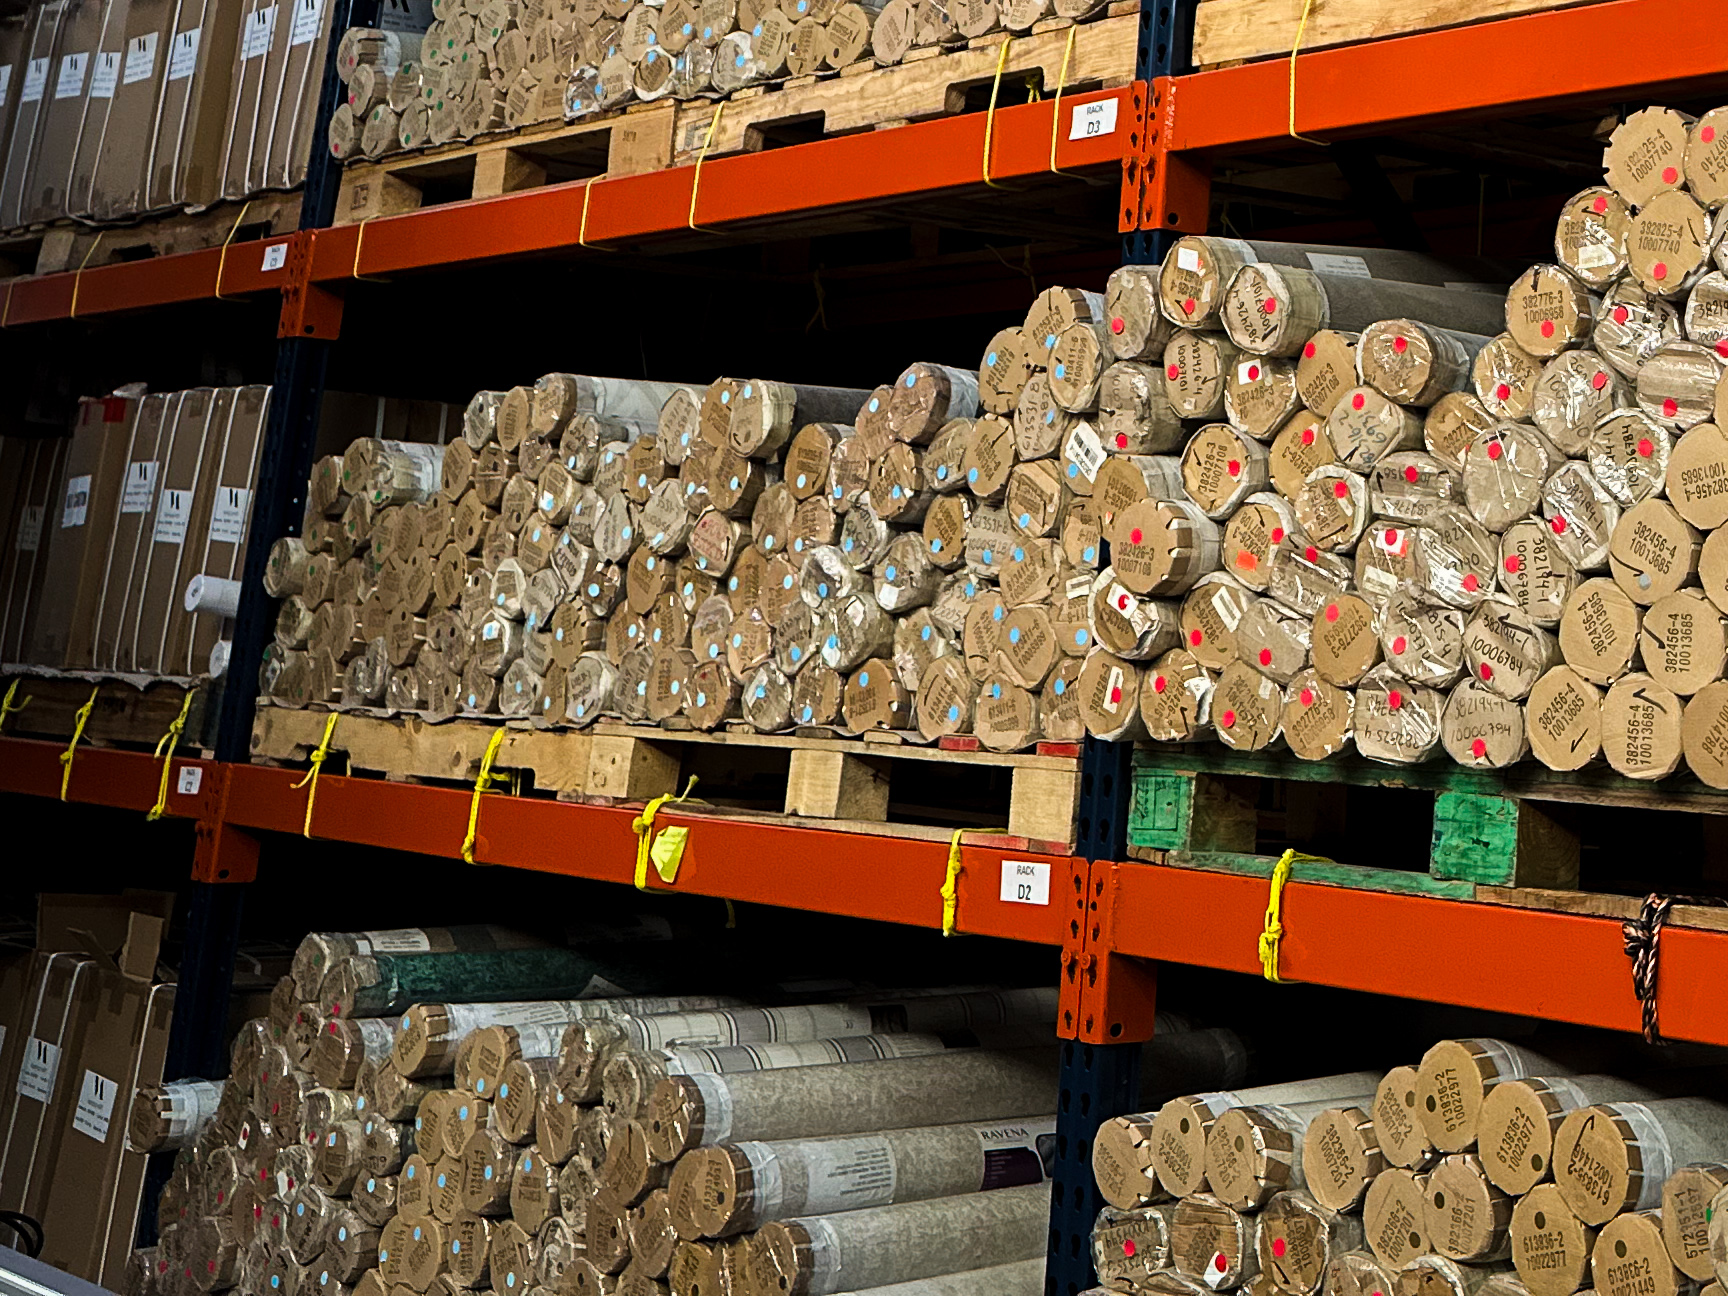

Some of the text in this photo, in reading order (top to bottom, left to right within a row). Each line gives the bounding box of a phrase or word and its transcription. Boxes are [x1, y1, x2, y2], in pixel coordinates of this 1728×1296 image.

[1087, 104, 1103, 114] RACK
[1087, 120, 1100, 134] D3
[1631, 140, 1672, 182] 10007740
[1634, 521, 1677, 557] 382456-4
[1667, 613, 1680, 674] 382456-4
[1539, 682, 1575, 729] 382456-4
[1548, 695, 1585, 741] 10013685
[1017, 865, 1034, 876] RACK
[1018, 884, 1031, 900] D2
[1435, 1072, 1455, 1133] 613836-2
[1449, 1068, 1465, 1126] 10022977
[981, 1128, 1029, 1139] RAVENA
[1498, 1106, 1526, 1164] 613836-2
[1508, 1117, 1535, 1173] 10022977
[1377, 1200, 1406, 1254] 382366-2
